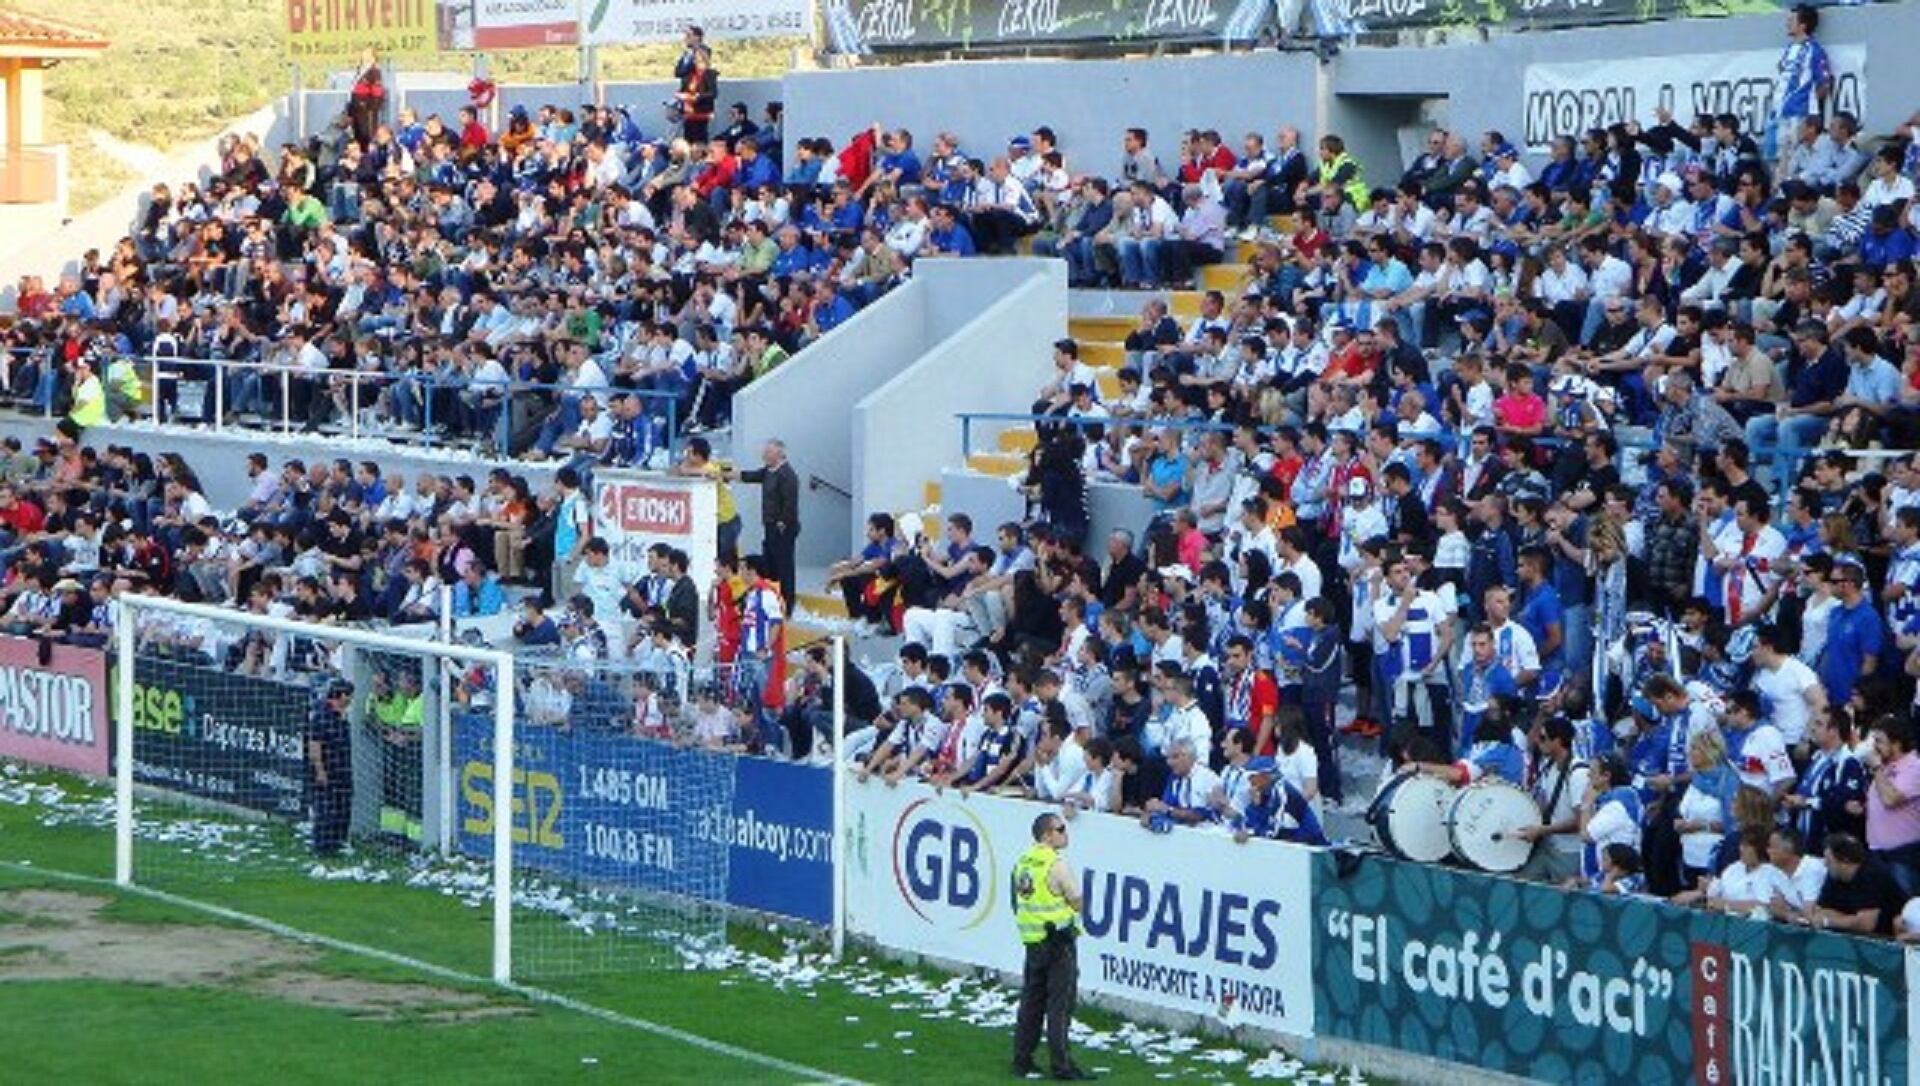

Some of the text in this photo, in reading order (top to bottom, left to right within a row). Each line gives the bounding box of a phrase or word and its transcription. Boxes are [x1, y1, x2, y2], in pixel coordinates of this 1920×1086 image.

[626, 498, 686, 525] EROSKI
[635, 772, 669, 811] OM
[584, 822, 673, 870] 100.8 FM
[905, 818, 980, 909] GB
[1082, 868, 1281, 970] UPAJES
[1100, 953, 1285, 1018] TRANSPORTE A EUROPA
[1402, 929, 1510, 1009] café
[1730, 951, 1892, 1086] BARSEL
